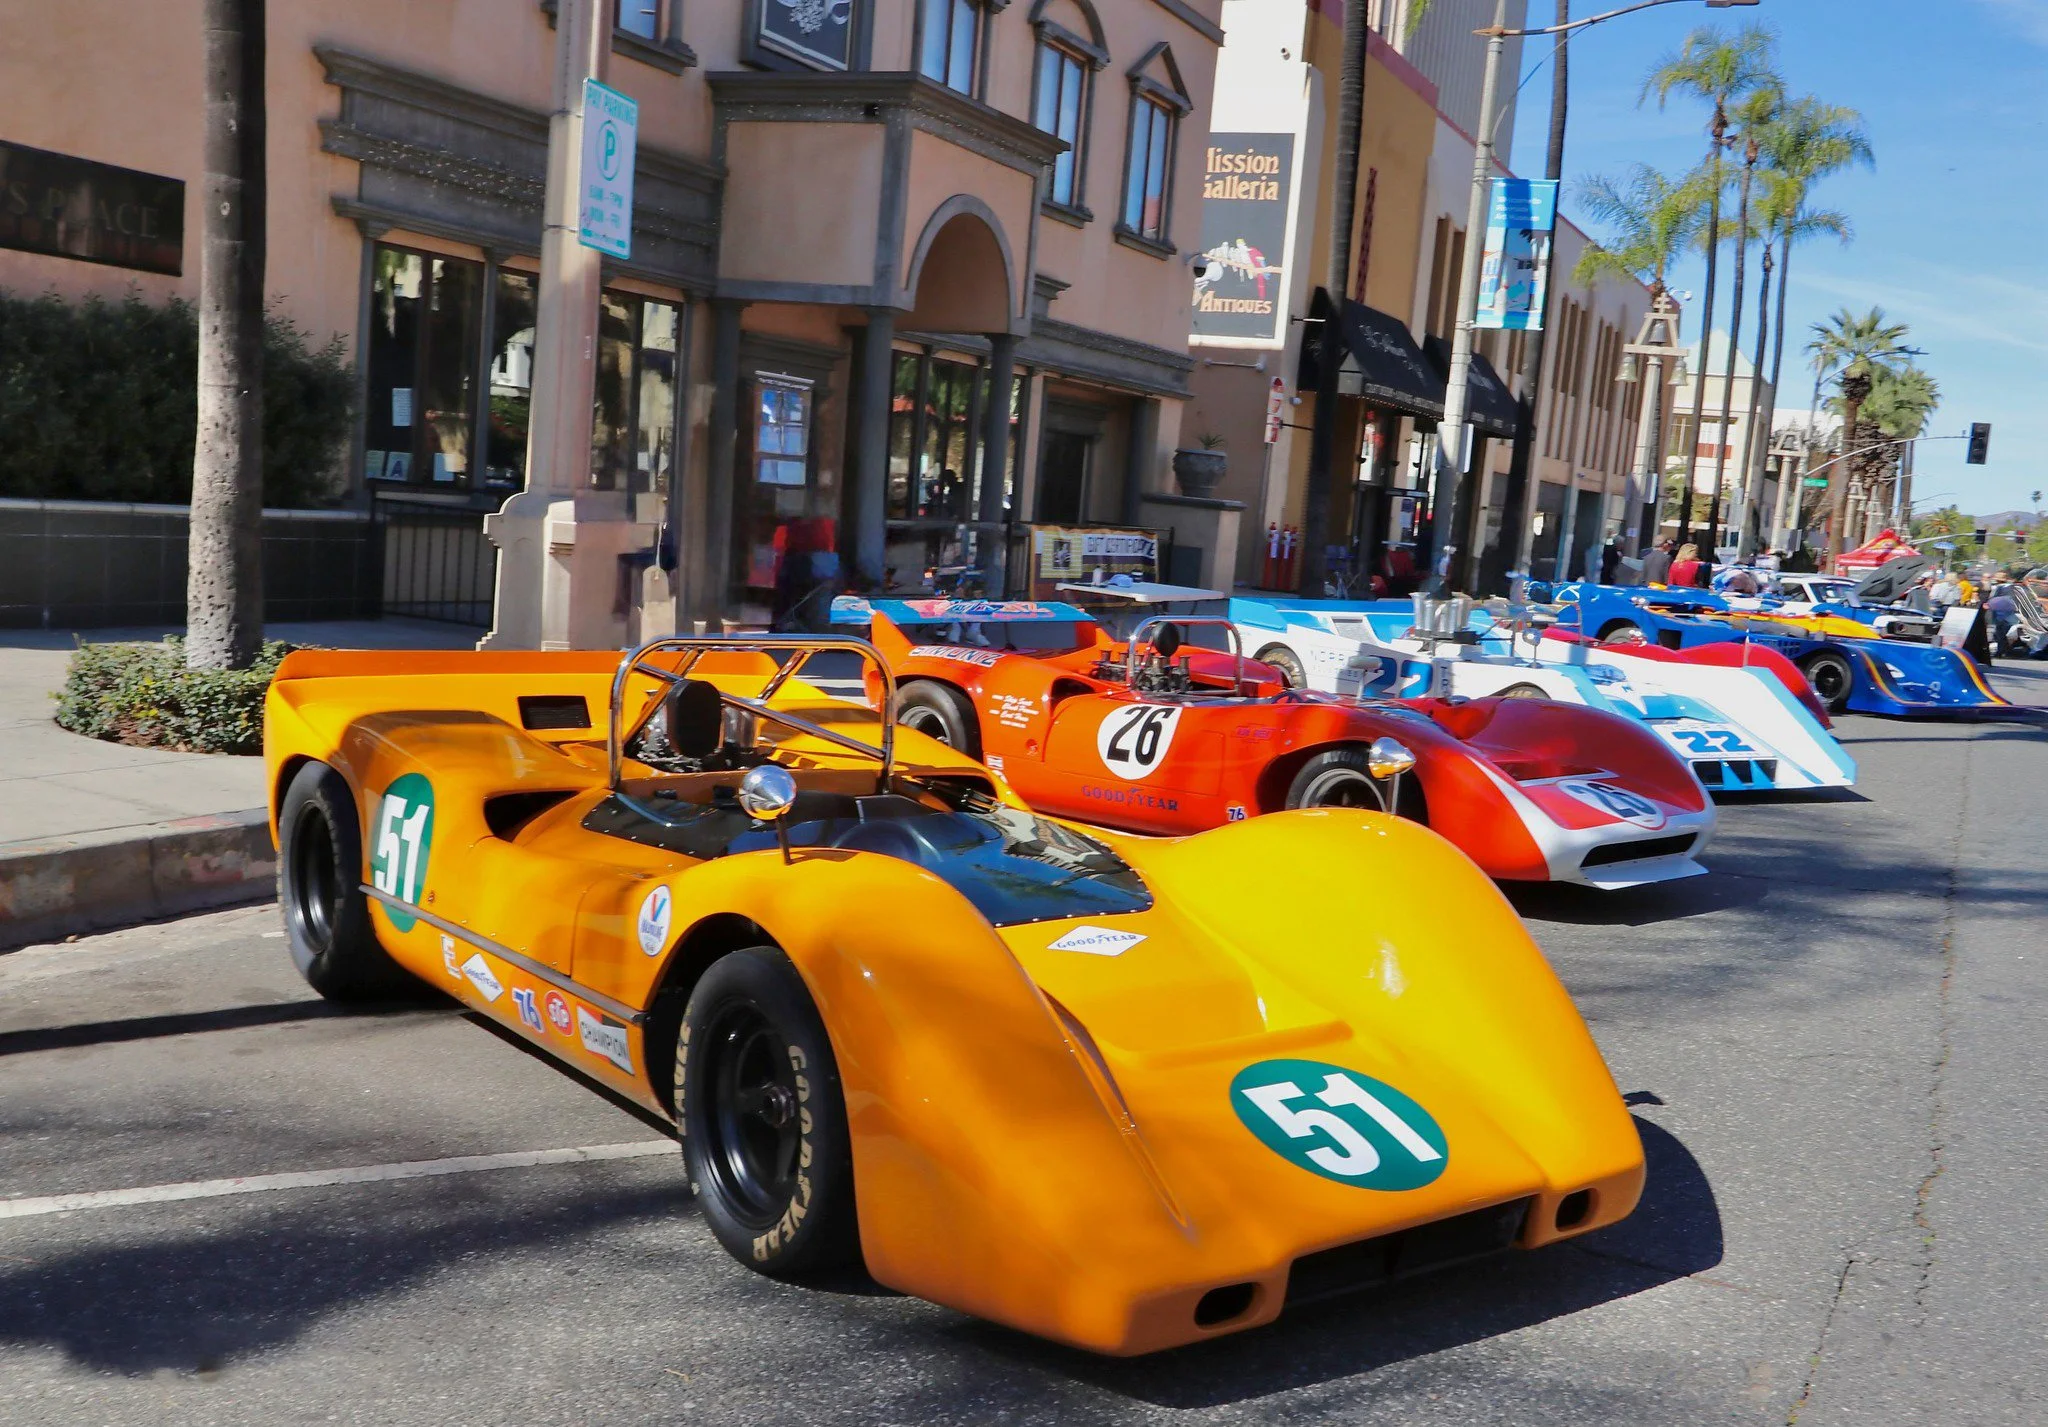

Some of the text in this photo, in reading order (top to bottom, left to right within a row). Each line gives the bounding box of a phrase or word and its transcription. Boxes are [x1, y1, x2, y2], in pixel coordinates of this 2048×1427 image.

[604, 129, 616, 171] P
[1362, 655, 1434, 699] 22
[1106, 706, 1176, 766] 26
[1671, 730, 1756, 752] 22
[1082, 784, 1178, 812] GOODYEAR
[1228, 808, 1245, 821] 76
[1567, 782, 1657, 818] 26
[375, 794, 430, 904] 51
[1057, 934, 1137, 949] GOODYEAR
[1241, 1073, 1443, 1176] 51
[752, 1045, 814, 1262] GOODYEAR
